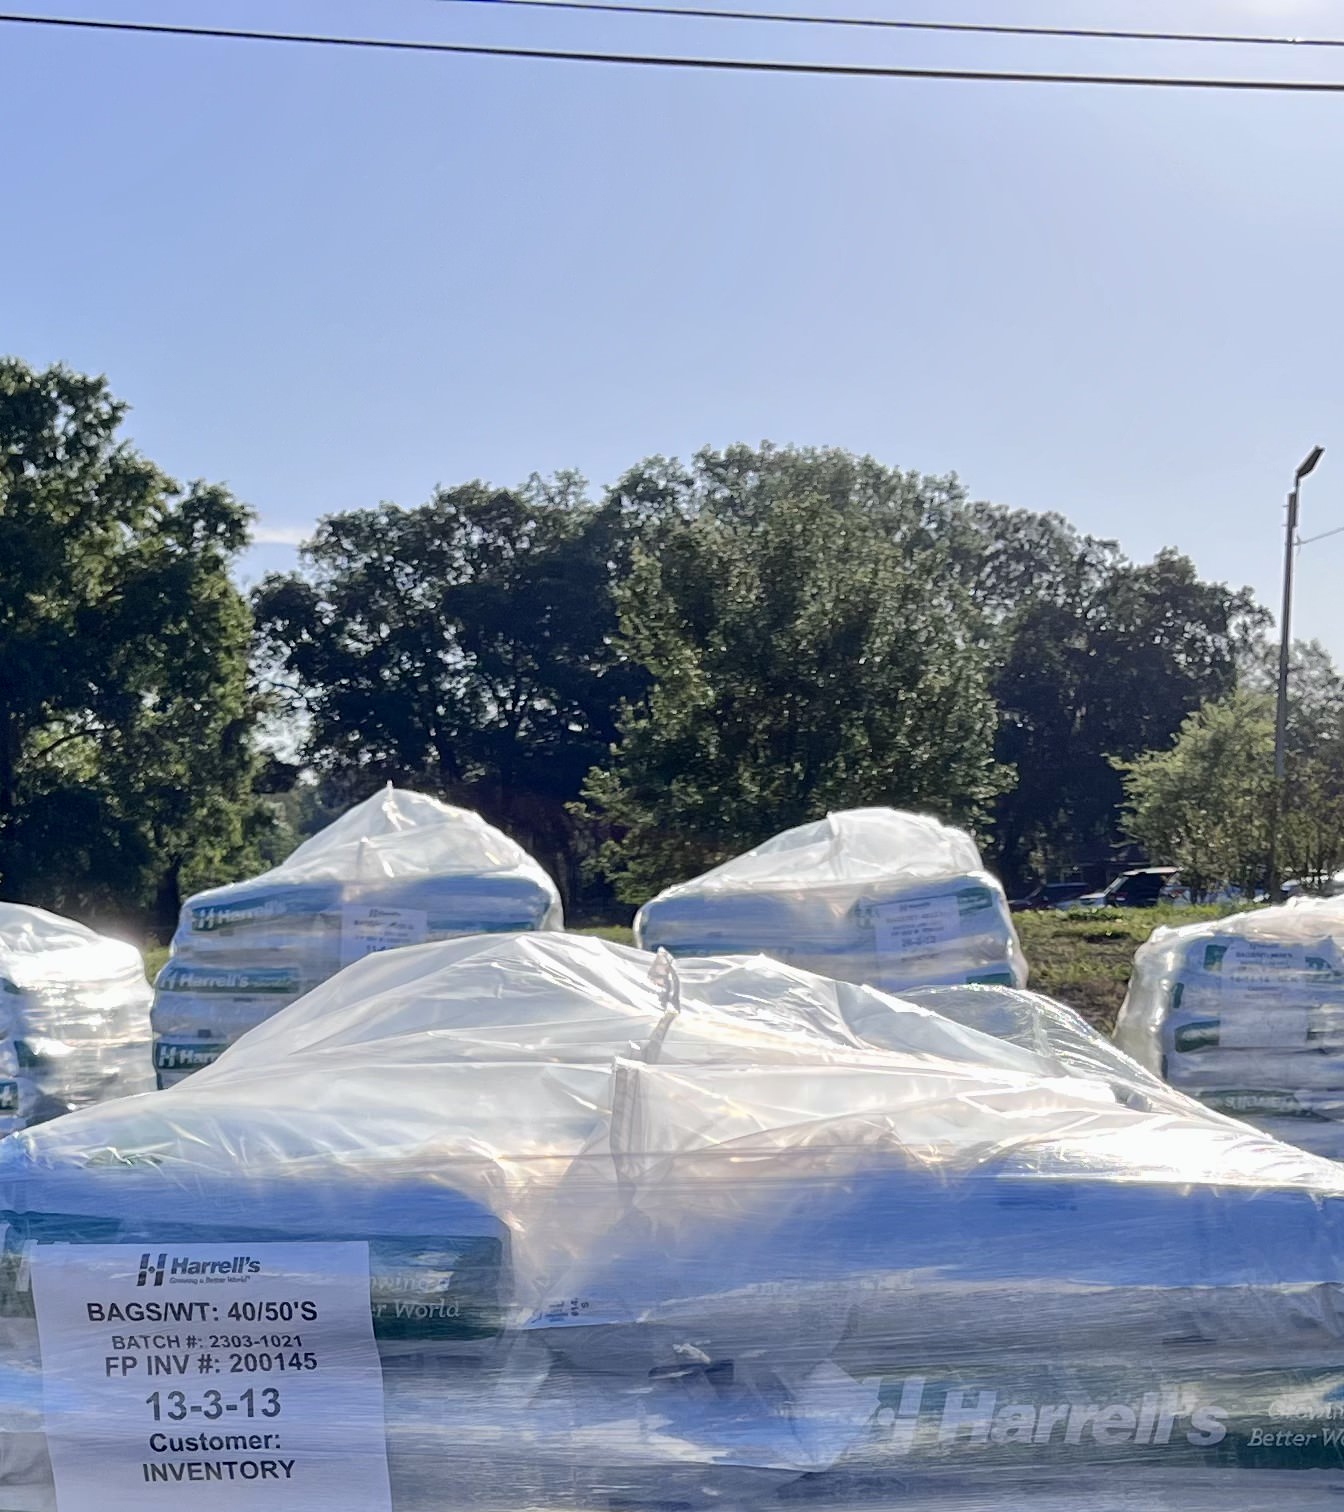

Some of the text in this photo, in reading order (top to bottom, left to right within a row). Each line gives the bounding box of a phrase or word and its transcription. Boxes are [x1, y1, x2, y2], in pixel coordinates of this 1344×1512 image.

[179, 974, 249, 988] Harrell's
[170, 1256, 261, 1275] Harrell's
[87, 1300, 318, 1322] BAGS/WT: 40/50'S
[112, 1335, 303, 1350] BATCH #: 2303-1021
[106, 1352, 318, 1377] FP INV #: 200145
[145, 1387, 281, 1421] 13-3-13
[937, 1390, 1228, 1447] Harrell's
[149, 1432, 281, 1452] Customer:
[1247, 1428, 1317, 1447] Better
[142, 1459, 296, 1482] INVENTORY
